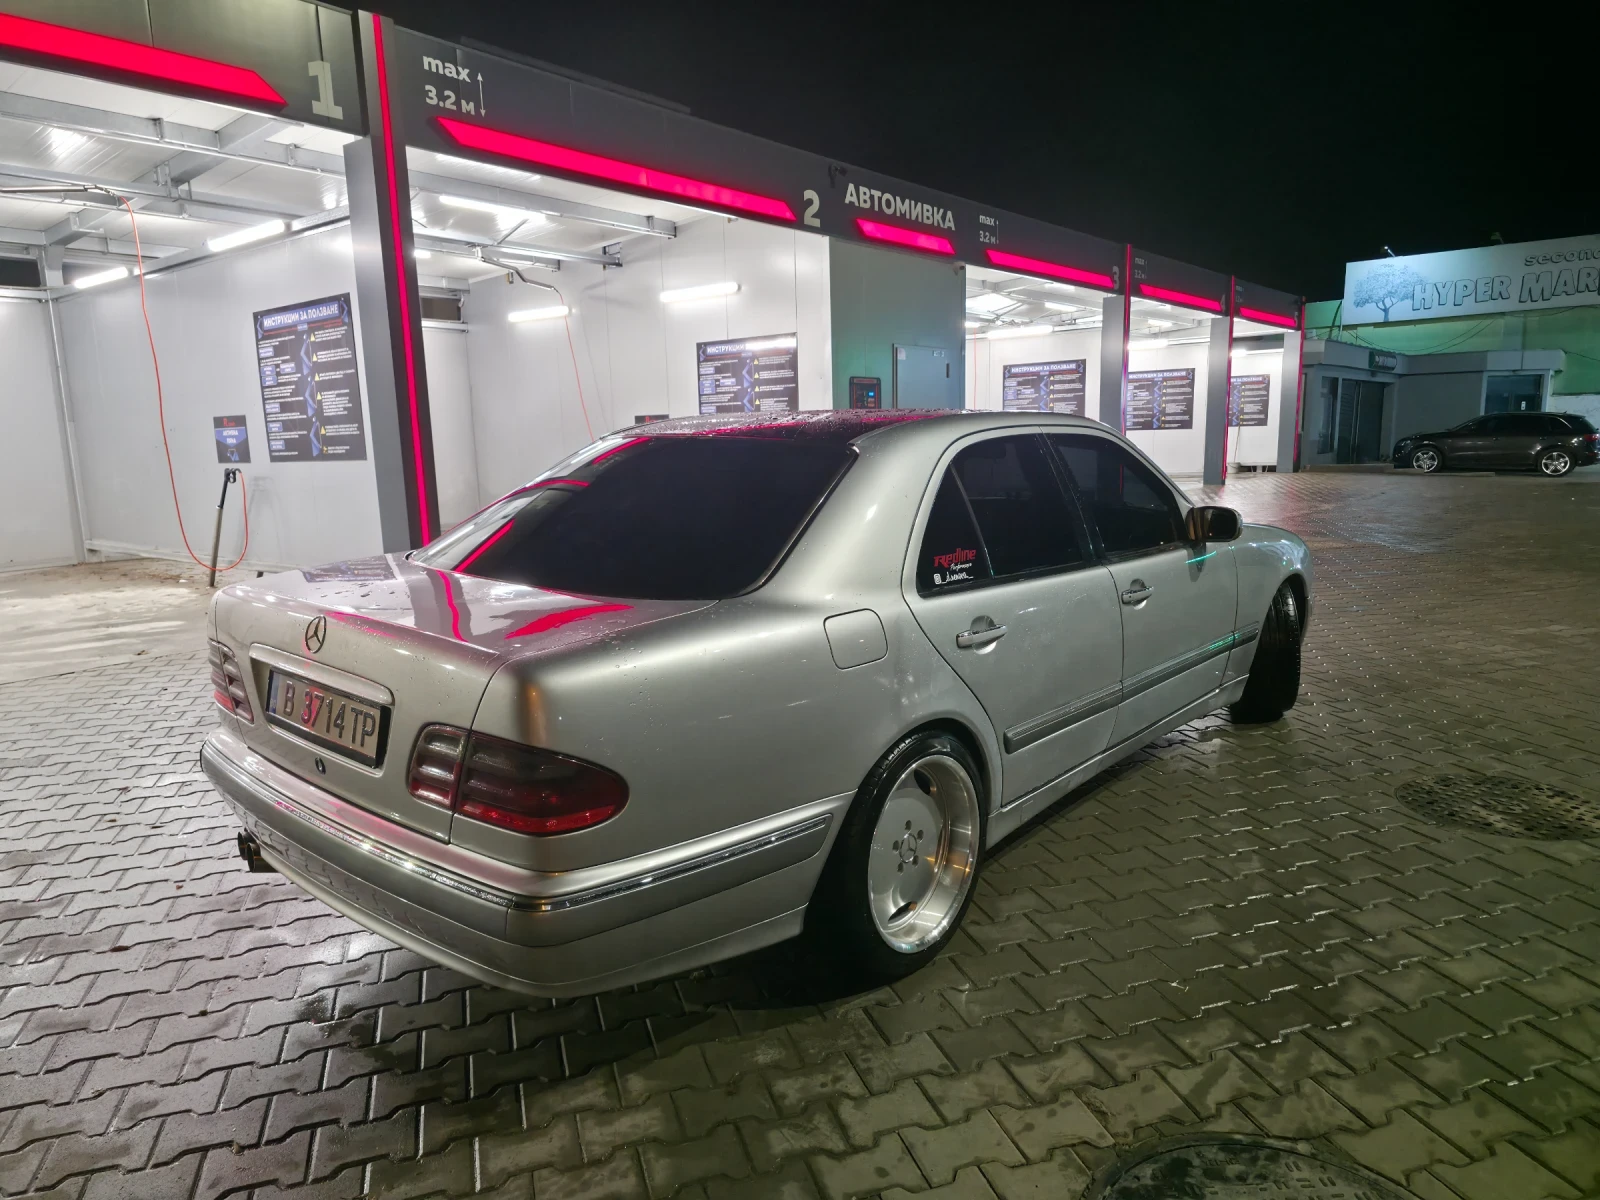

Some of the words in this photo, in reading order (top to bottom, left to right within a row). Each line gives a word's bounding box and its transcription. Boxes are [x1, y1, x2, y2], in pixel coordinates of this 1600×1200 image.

[423, 56, 471, 83] max
[308, 61, 343, 120] 1
[425, 85, 457, 110] 3.2
[803, 190, 821, 228] 2
[844, 183, 956, 231] АВТОМИВКА
[979, 215, 995, 226] max
[979, 231, 990, 243] 3.2
[1112, 265, 1120, 290] 3
[1412, 275, 1512, 311] HYPER
[1519, 267, 1600, 303] MAR
[263, 312, 299, 327] ИНСТРУКЦИИ
[300, 310, 308, 320] ЗА
[308, 303, 338, 319] ПОЛЗВАНЕ
[707, 343, 745, 353] ИНСТРУКЦИИ
[1011, 365, 1043, 373] ИНСТРУКЦИИ
[933, 547, 977, 568] Redline
[283, 680, 296, 717] B
[300, 689, 346, 739] 3714
[350, 706, 376, 747] TP
